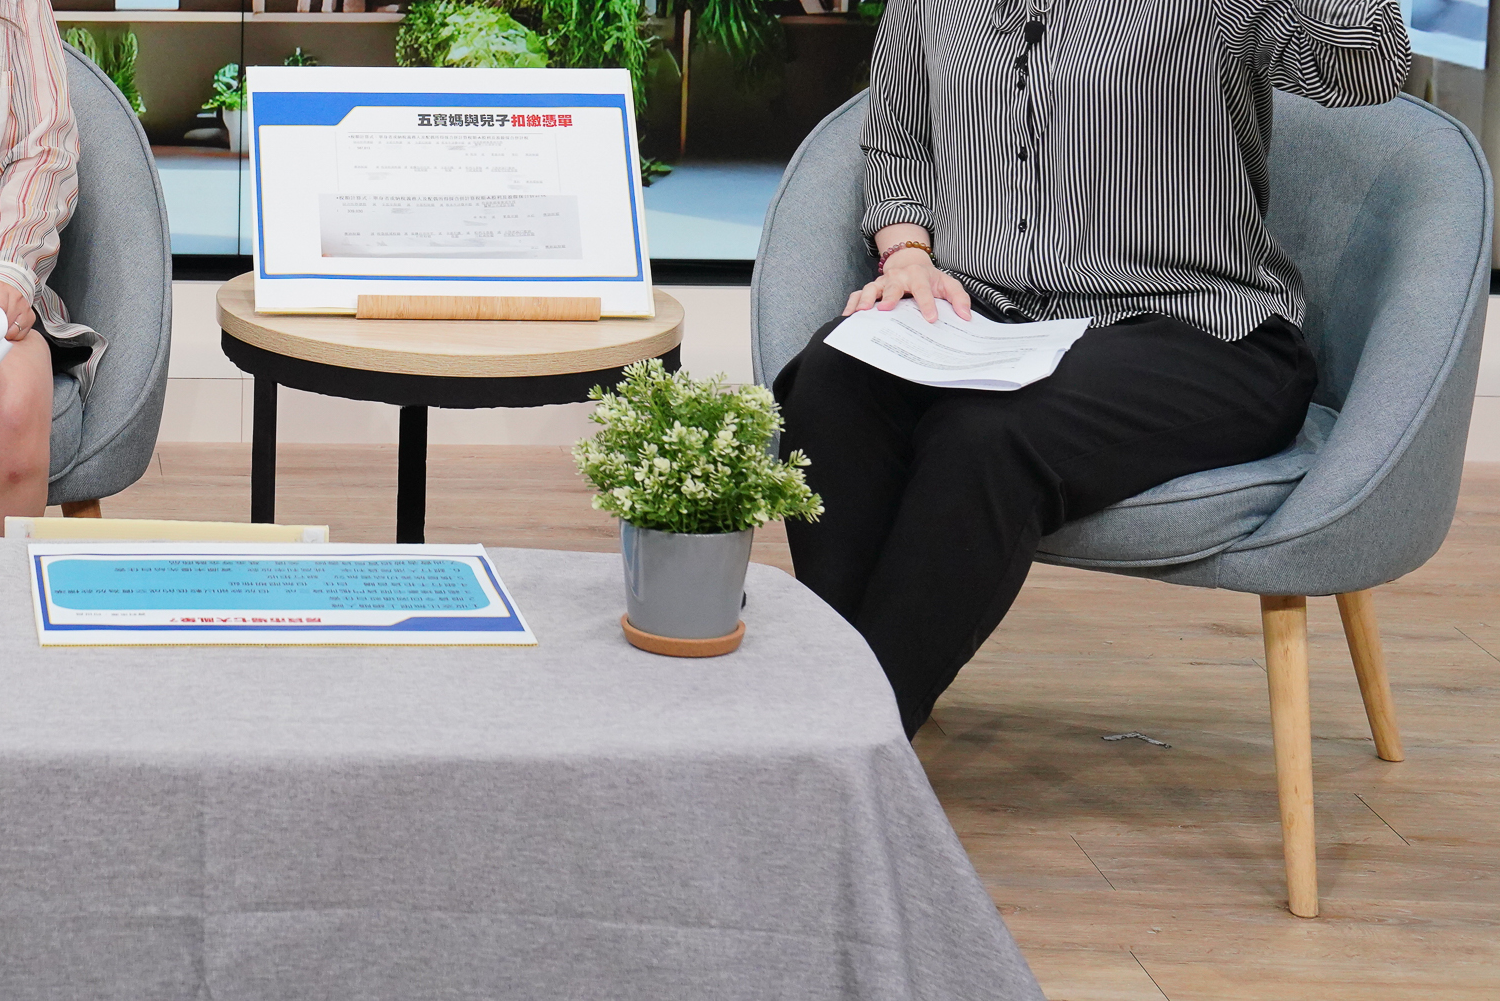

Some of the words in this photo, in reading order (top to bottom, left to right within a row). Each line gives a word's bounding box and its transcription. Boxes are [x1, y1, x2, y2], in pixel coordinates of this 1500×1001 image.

[417, 113, 573, 127] 五寶媽與兒子扣繳憑單
